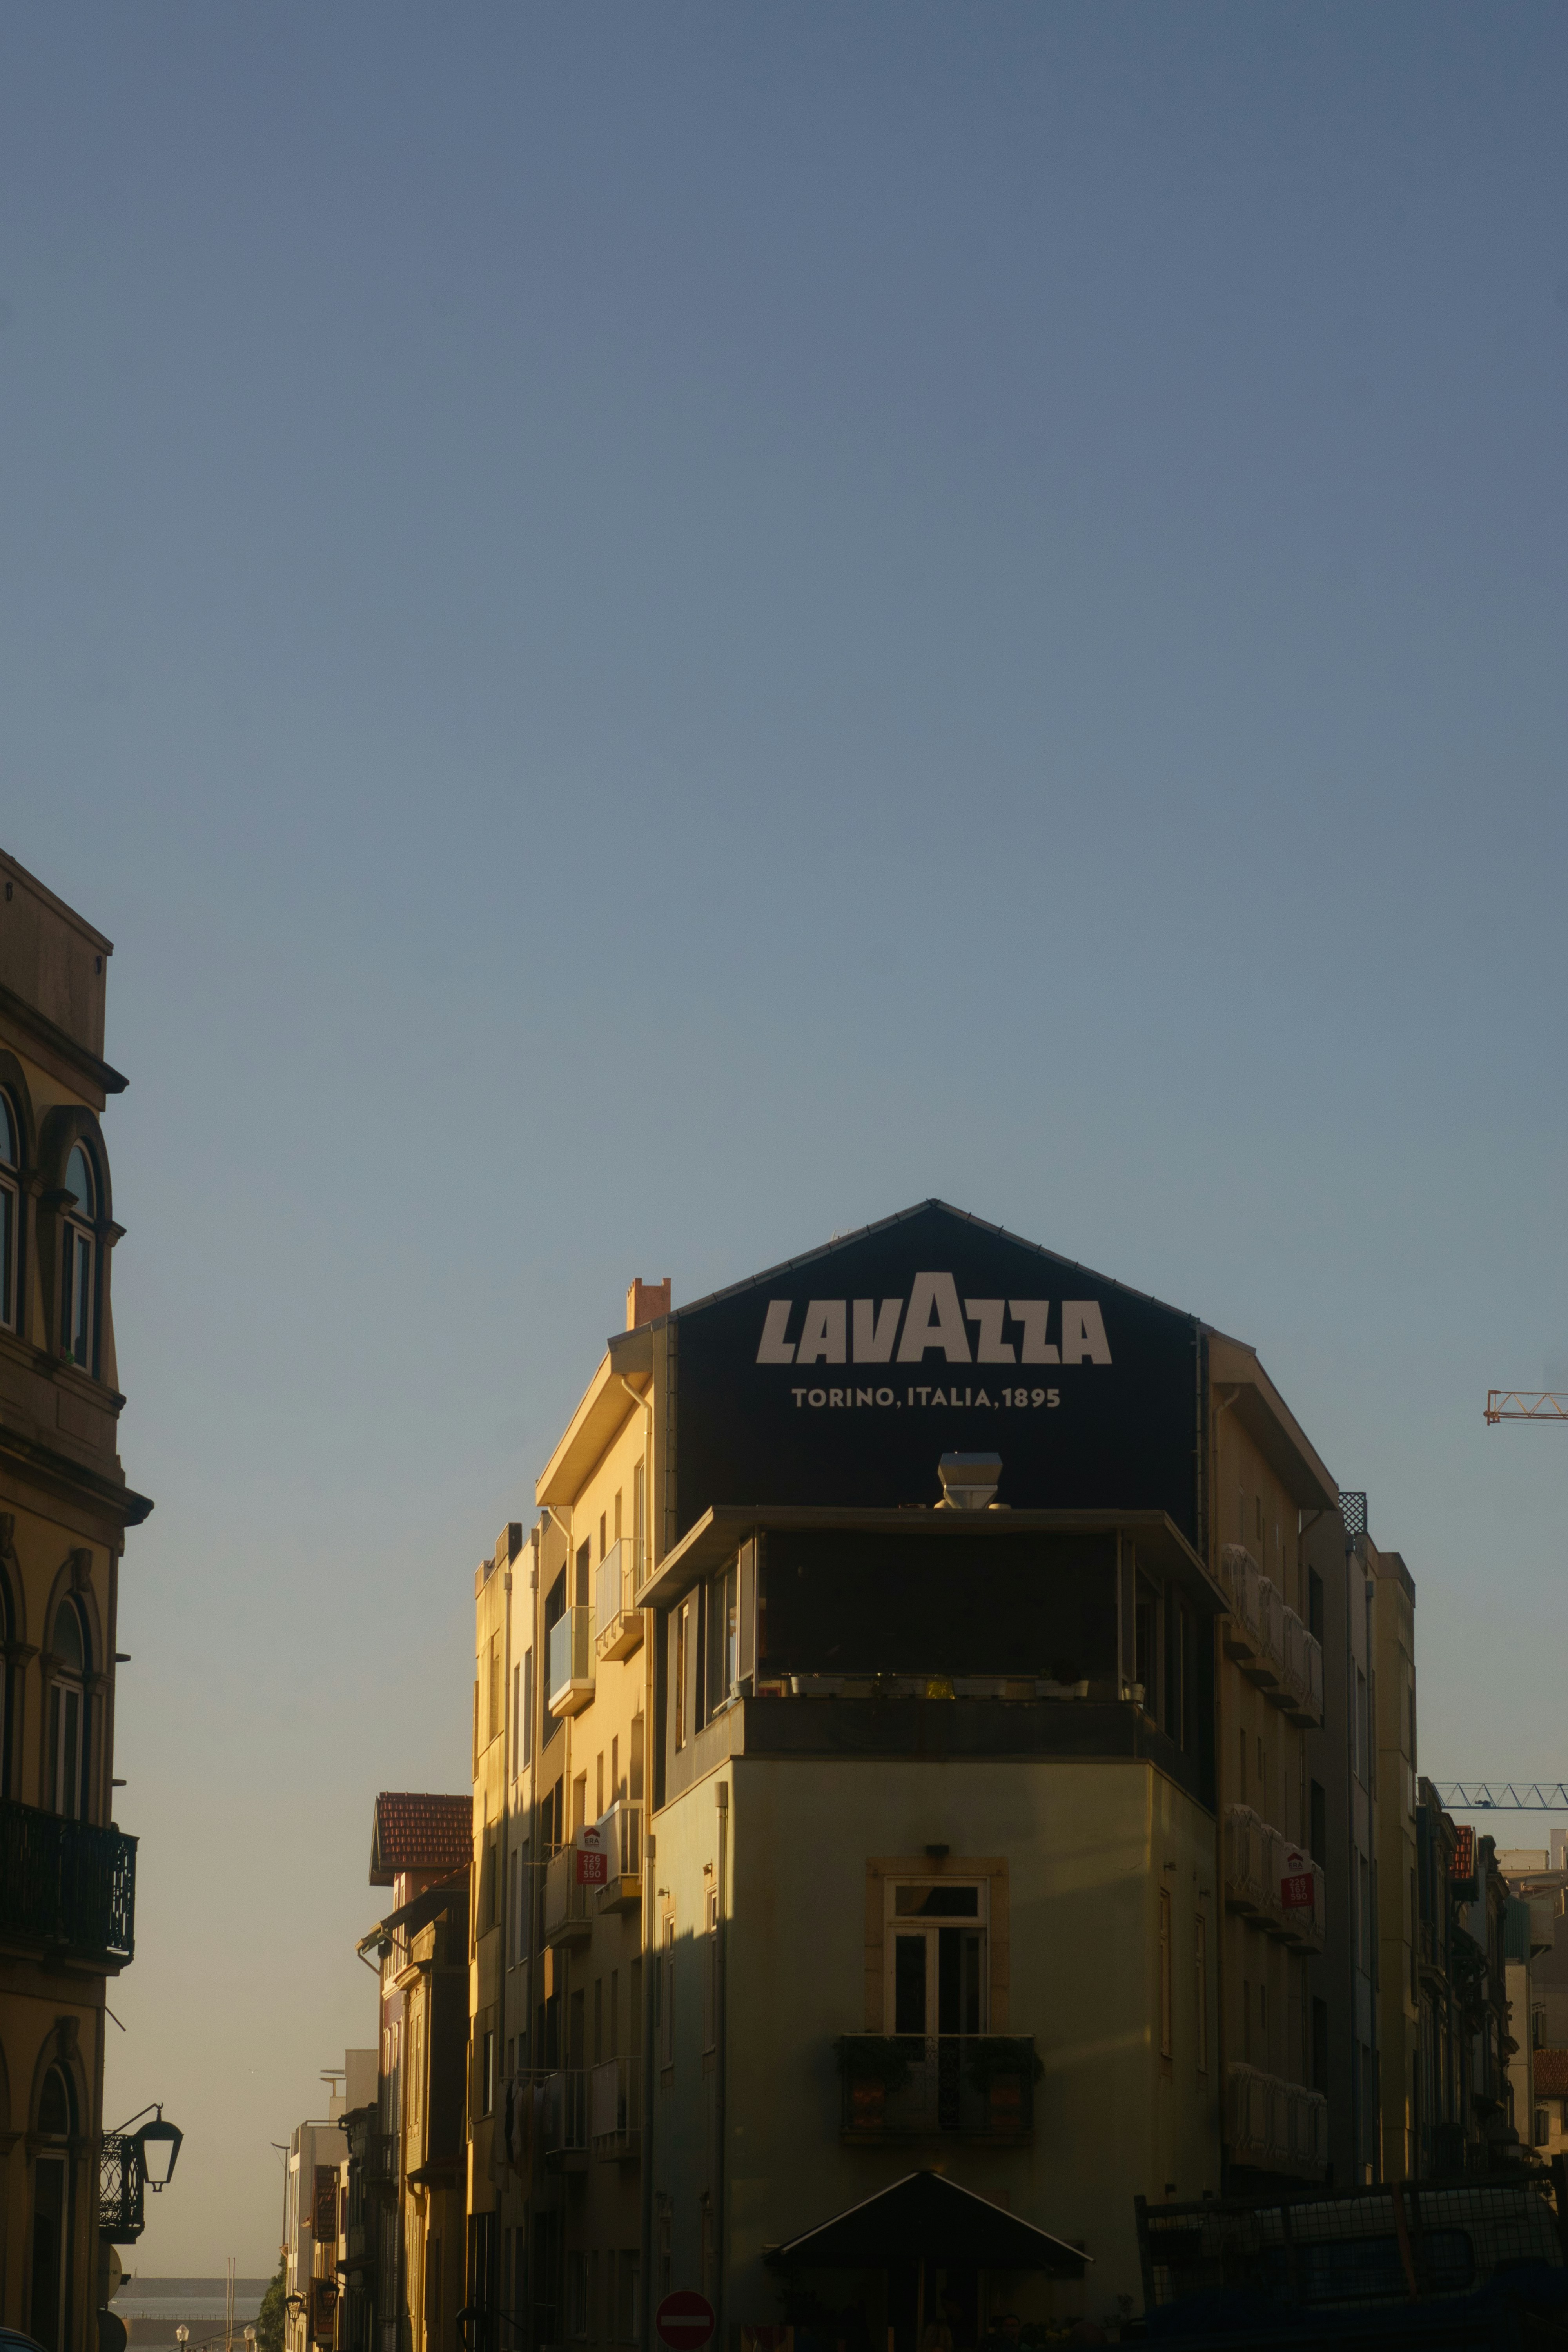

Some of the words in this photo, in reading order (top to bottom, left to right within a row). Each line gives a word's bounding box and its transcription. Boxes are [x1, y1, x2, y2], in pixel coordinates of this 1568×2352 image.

[755, 1272, 1113, 1365] LAVAZZA
[791, 1388, 901, 1409] TORINO,
[908, 1387, 999, 1410] ITALIA,
[1002, 1388, 1060, 1408] 1895
[583, 1855, 601, 1863] 226
